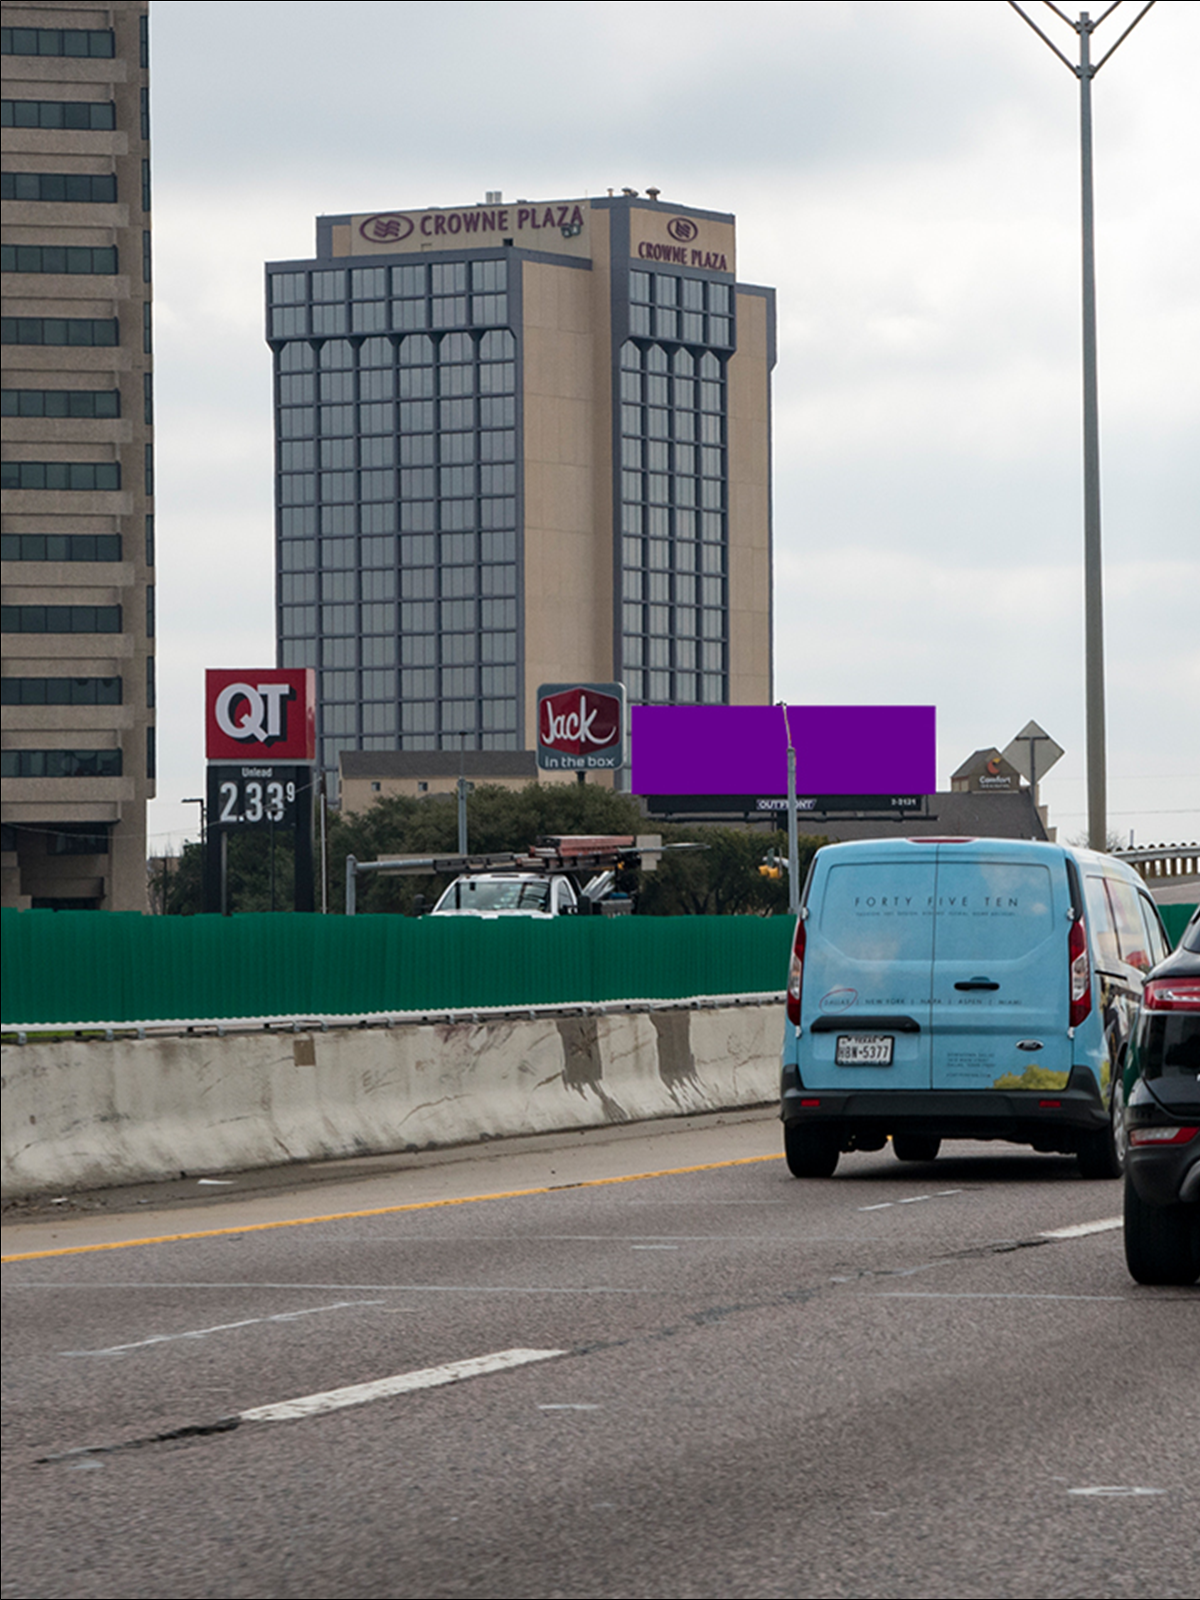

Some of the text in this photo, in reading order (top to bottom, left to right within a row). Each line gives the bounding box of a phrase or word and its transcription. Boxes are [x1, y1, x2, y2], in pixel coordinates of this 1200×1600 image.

[420, 205, 585, 237] CROWNE PLAZA
[638, 241, 727, 271] CROWNE PLAZA
[214, 682, 292, 744] QT
[541, 695, 617, 745] Jack
[241, 767, 273, 778] Unlead
[561, 756, 585, 768] the
[587, 755, 616, 768] box
[855, 897, 1018, 907] FORTY FIVE TEN
